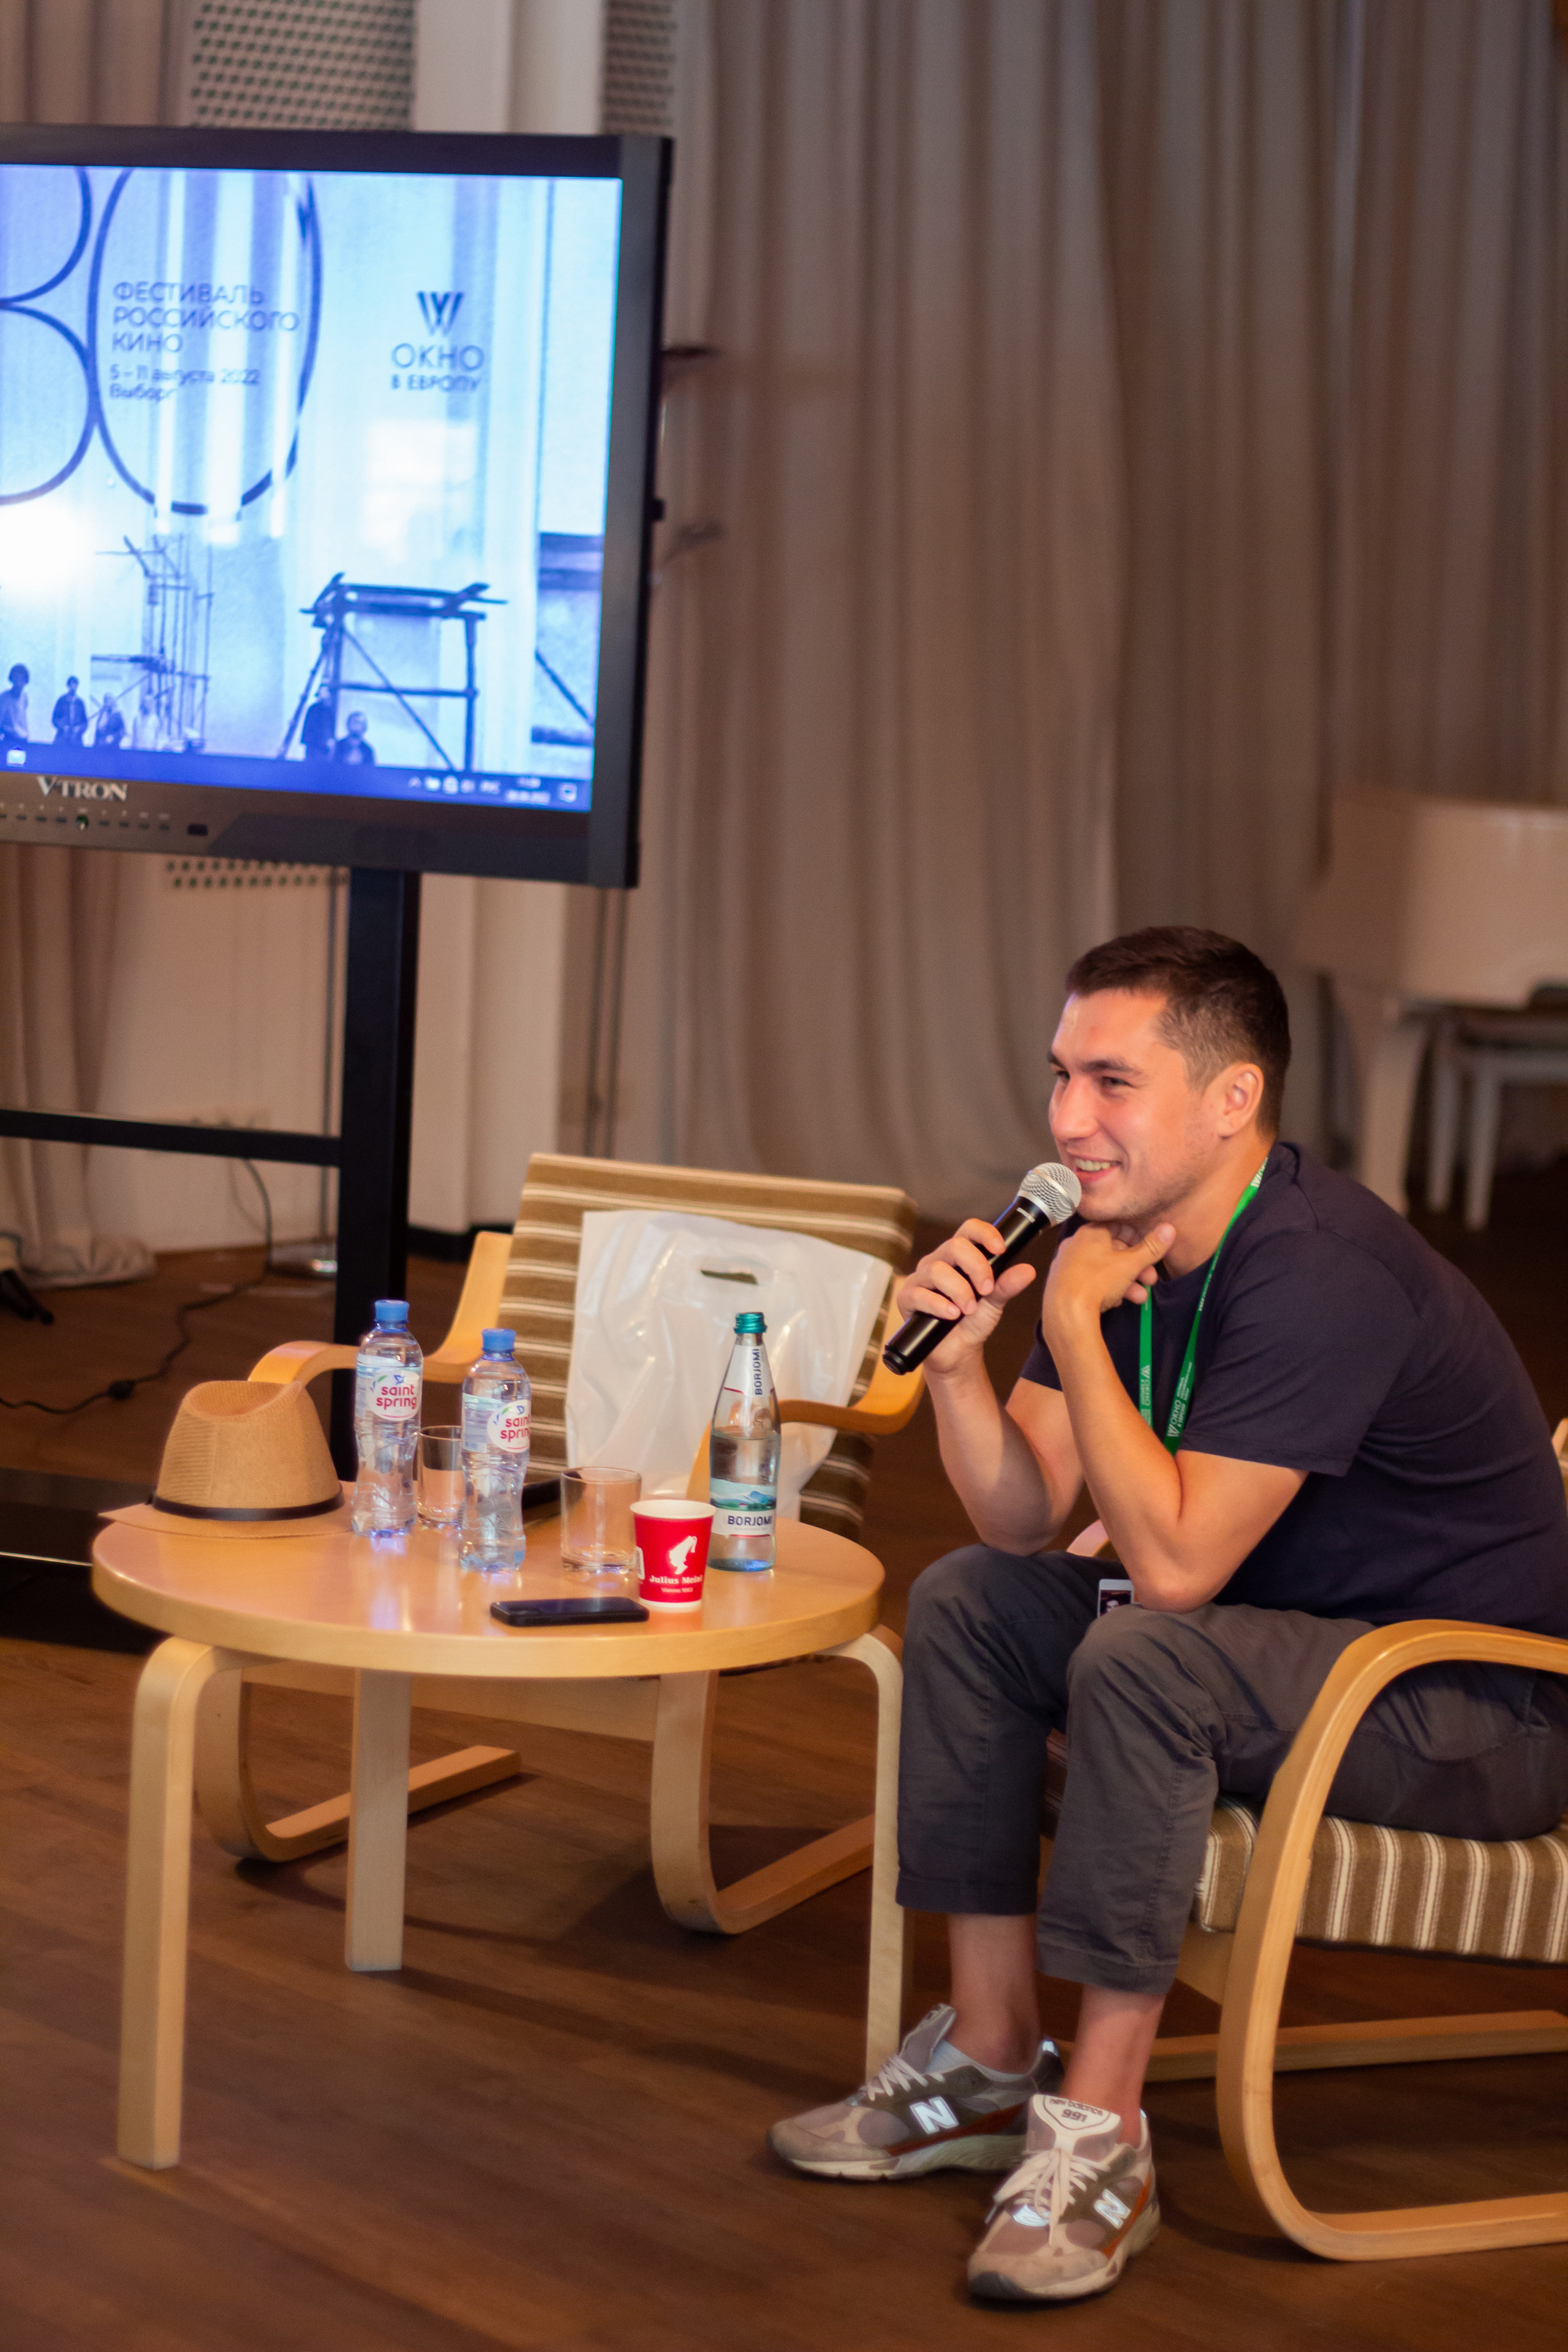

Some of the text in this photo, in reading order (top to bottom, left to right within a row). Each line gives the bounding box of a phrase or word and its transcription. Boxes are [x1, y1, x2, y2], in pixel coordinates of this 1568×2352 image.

[113, 281, 265, 304] ФЕСТИВАЛЬ
[113, 306, 300, 331] РОССИЙСКОГО
[111, 333, 183, 352] КИНО
[391, 342, 484, 371] ОКНО
[407, 374, 481, 391] ЕВРОПУ
[752, 1349, 763, 1395] BORJOMI
[381, 1384, 415, 1396] saint
[376, 1397, 417, 1410] spring
[1170, 1400, 1182, 1425] ОКНО
[500, 1428, 530, 1442] sprin
[649, 1575, 680, 1585] Julius
[909, 2096, 959, 2134] N
[1061, 2109, 1088, 2122] 991
[1094, 2188, 1131, 2230] N
